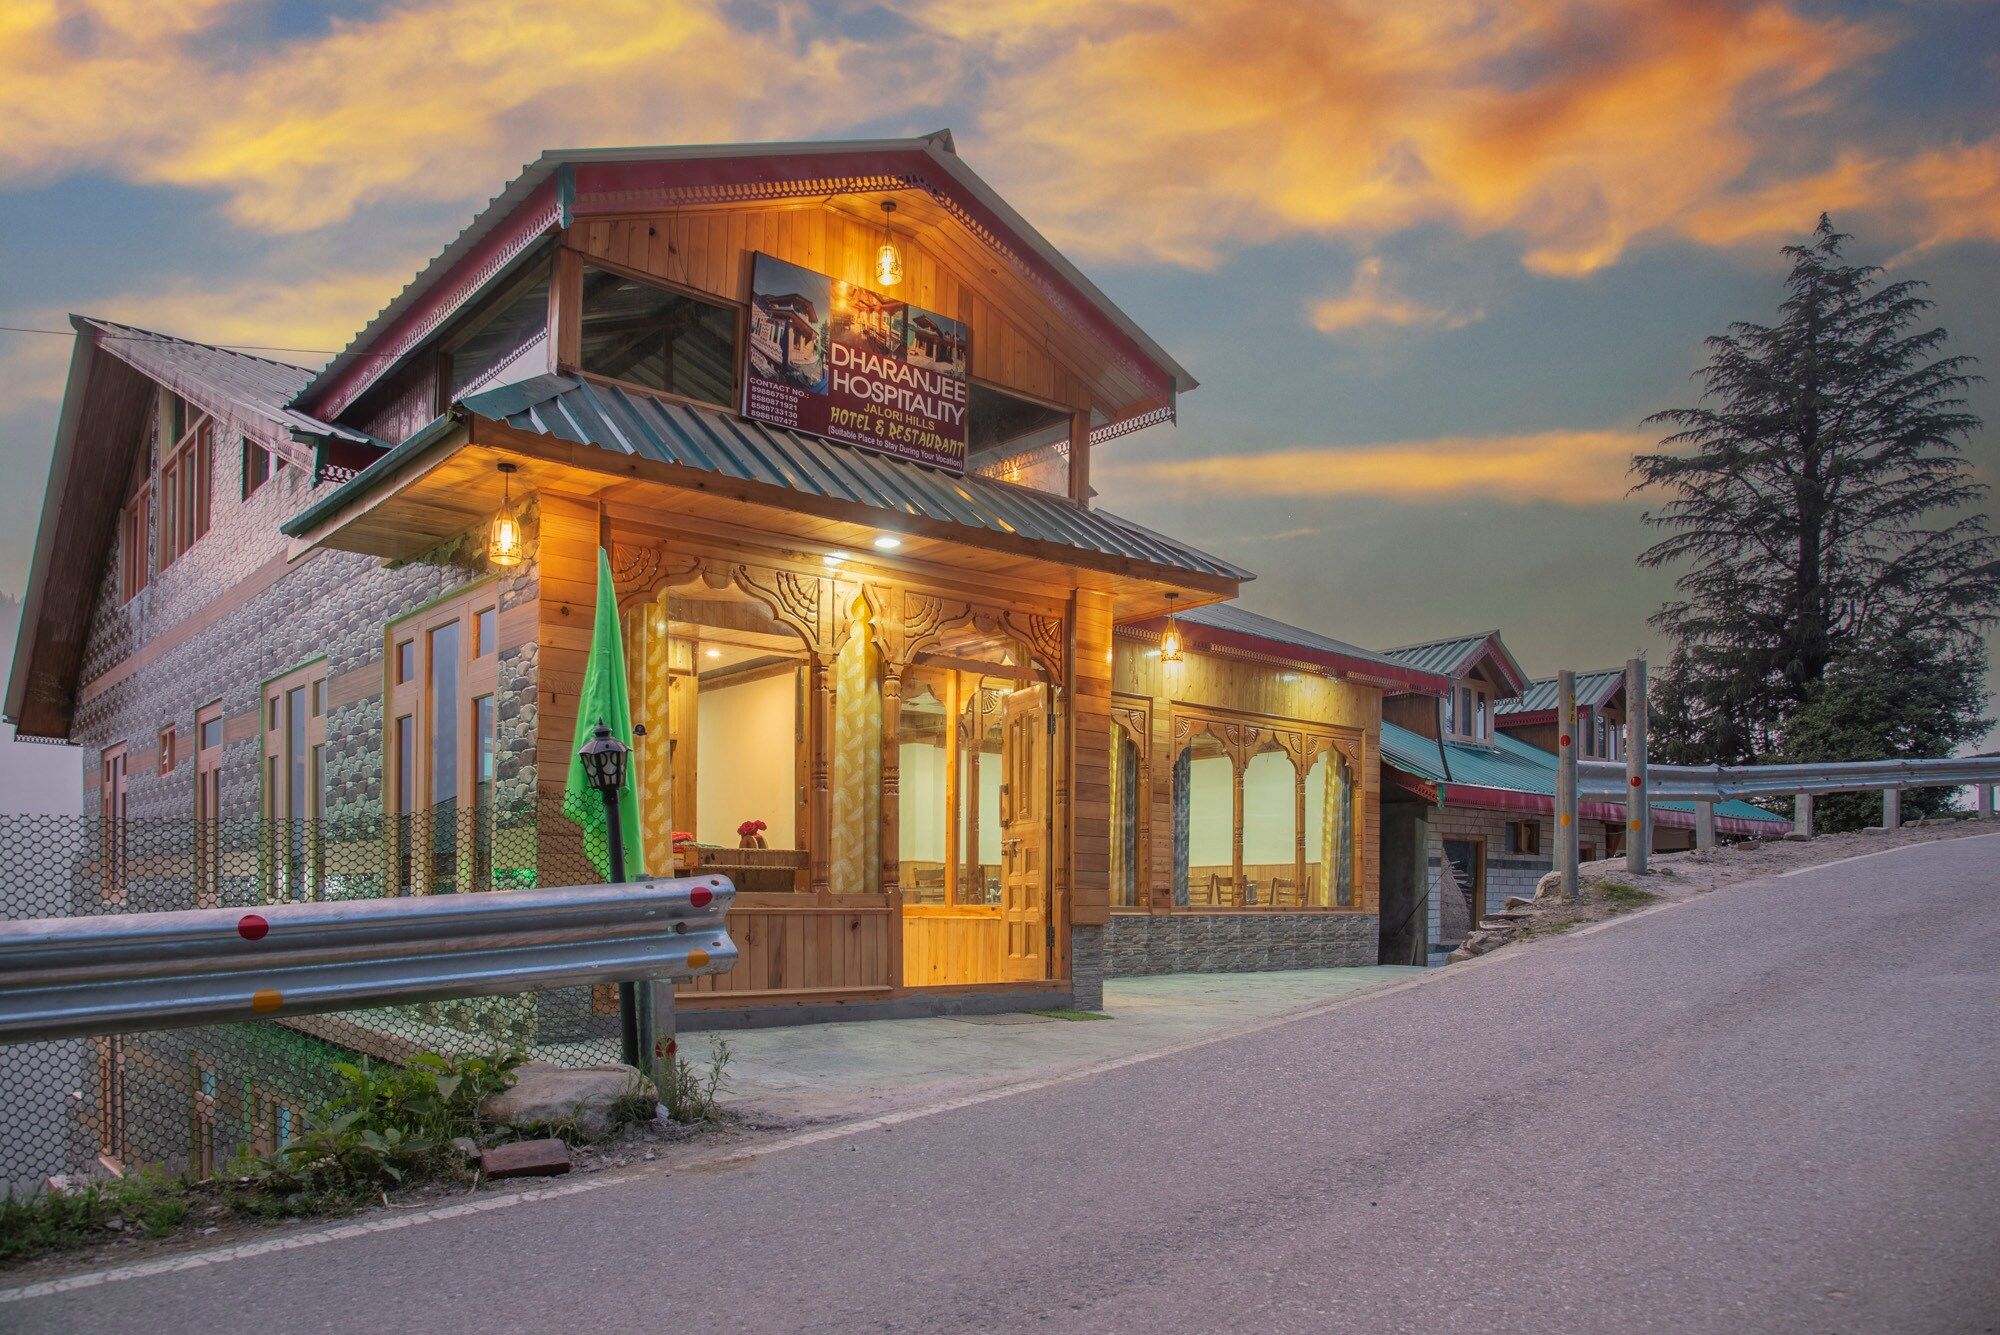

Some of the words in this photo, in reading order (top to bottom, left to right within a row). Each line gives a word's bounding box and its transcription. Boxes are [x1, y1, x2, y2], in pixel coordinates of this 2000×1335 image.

[750, 377, 790, 393] CONTACT
[831, 342, 966, 402] DHARANJEE
[751, 394, 798, 411] 8580871921
[833, 369, 965, 426] HOSPITALITY
[830, 406, 871, 431] HOTEL
[875, 418, 884, 437] &
[888, 422, 965, 457] RESTAURANT
[864, 403, 903, 422] JALORI
[906, 414, 935, 430] HILLS
[828, 426, 856, 440] (Suitable
[858, 432, 876, 444] Place
[876, 439, 883, 447] to
[884, 440, 898, 452] Stay
[899, 444, 920, 458] During
[920, 449, 934, 460] Your
